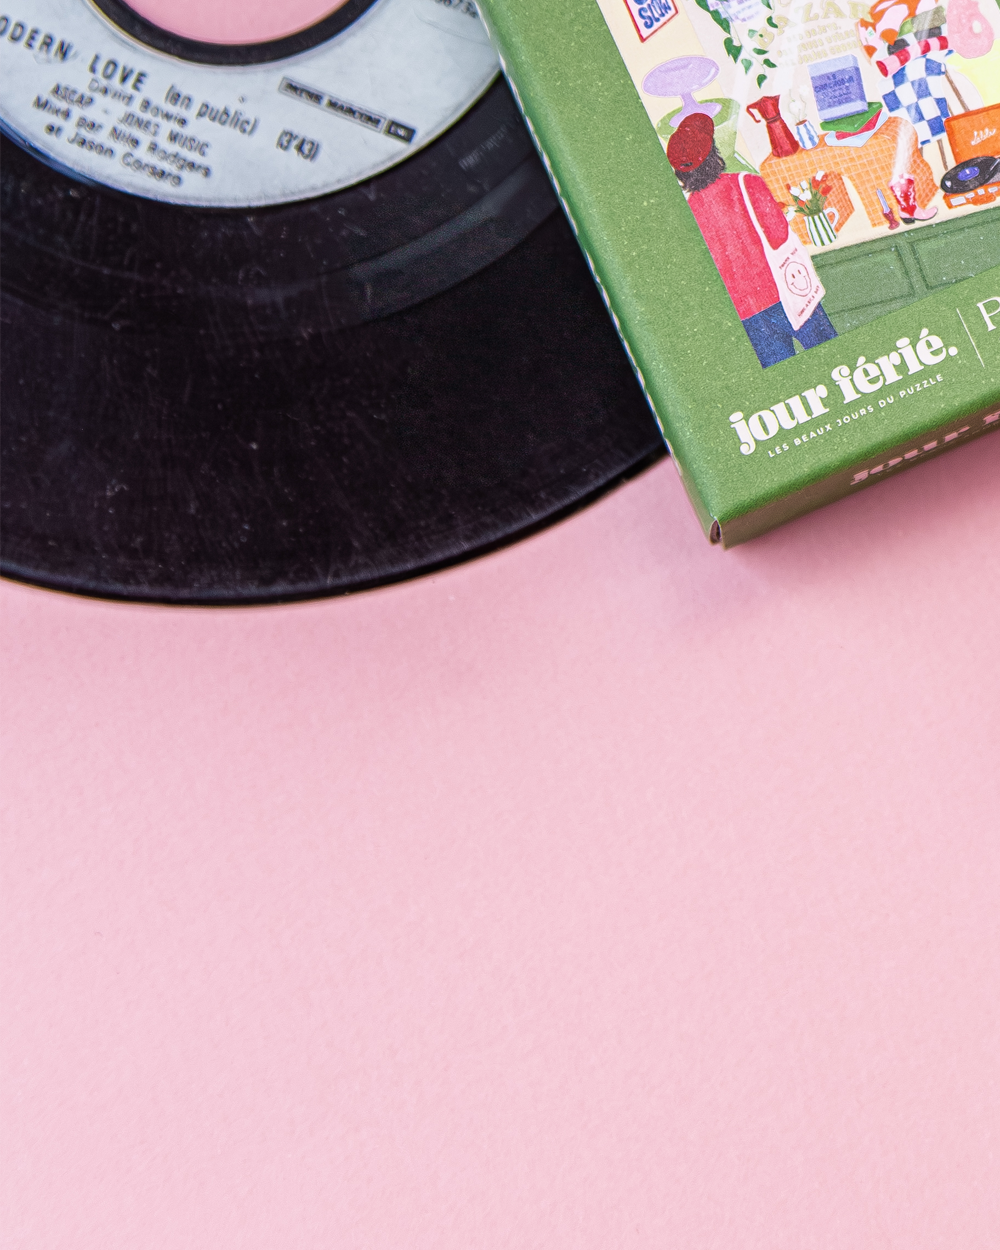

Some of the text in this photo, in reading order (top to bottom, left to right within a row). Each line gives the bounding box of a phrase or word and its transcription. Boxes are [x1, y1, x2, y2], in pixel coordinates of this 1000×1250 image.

[51, 83, 94, 109] ASCAP
[118, 112, 159, 137] JONES
[167, 129, 209, 157] MUSIC
[87, 78, 187, 128] David Bowie
[88, 54, 147, 91] LOVE
[196, 100, 259, 136] public)
[67, 132, 115, 158] Jason
[147, 141, 211, 178] Rodgers
[728, 327, 958, 456] jour férié.
[768, 374, 944, 458] LES BEAUX JOURS DU PUZZLE
